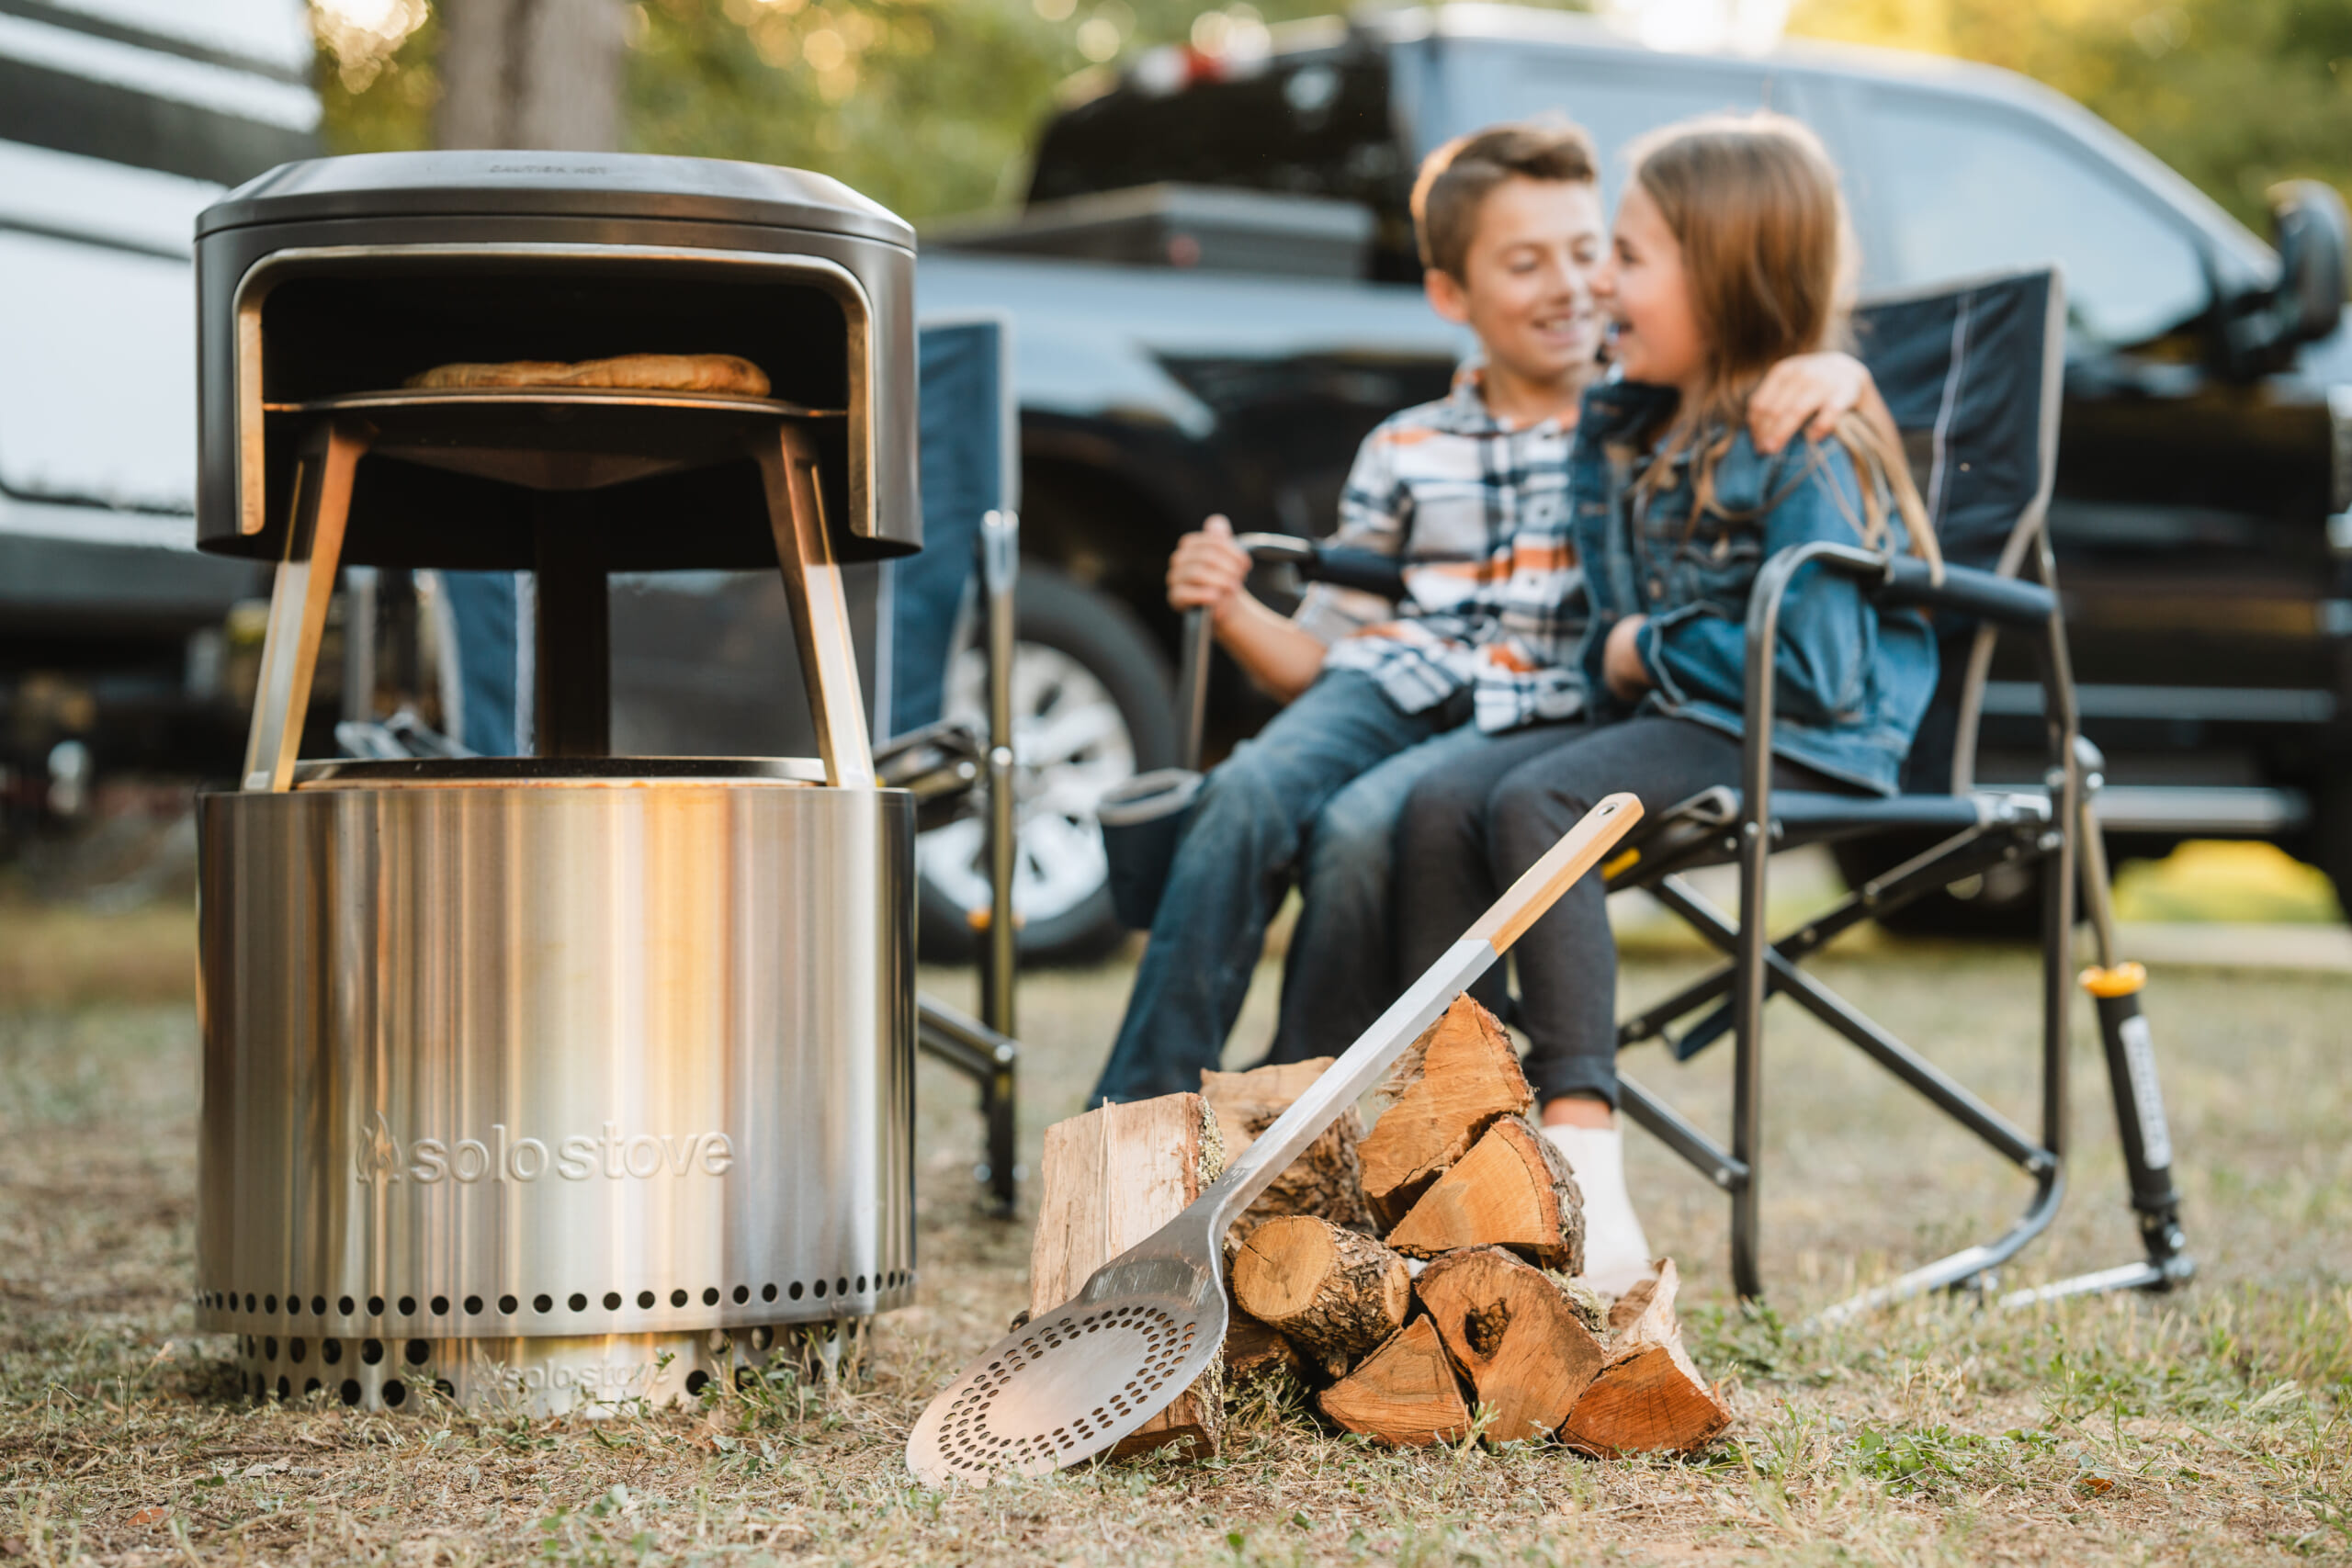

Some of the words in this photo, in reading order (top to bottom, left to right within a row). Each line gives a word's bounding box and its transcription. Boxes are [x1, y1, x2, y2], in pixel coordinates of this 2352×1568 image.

[409, 1123, 549, 1183] solo
[558, 1120, 734, 1180] stove
[504, 1359, 572, 1390] solo
